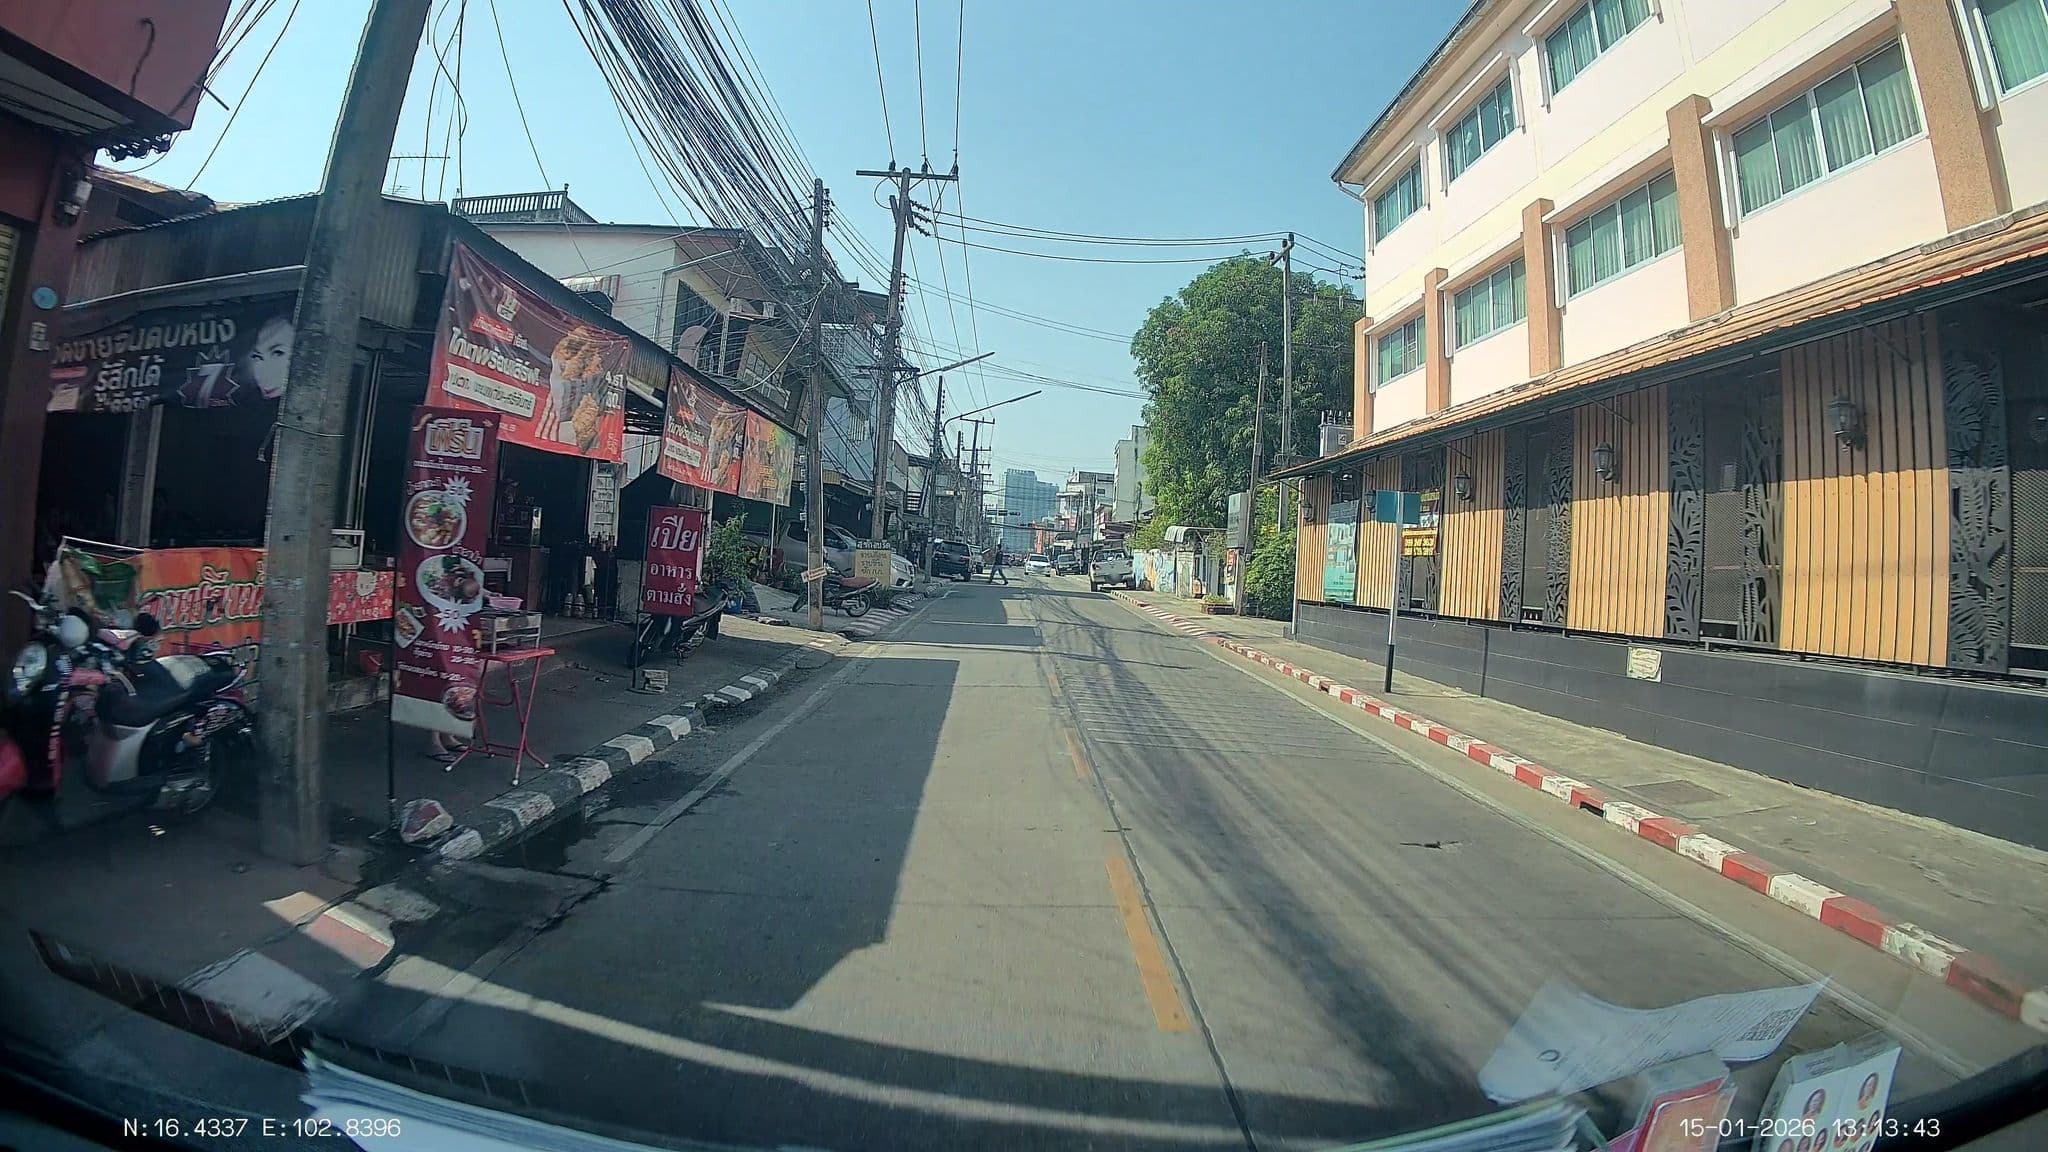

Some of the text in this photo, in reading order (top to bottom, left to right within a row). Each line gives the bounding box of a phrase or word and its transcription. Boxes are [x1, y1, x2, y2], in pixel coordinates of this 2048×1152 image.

[650, 563, 693, 580] อาหาร
[646, 583, 692, 606] ตามสั่ง
